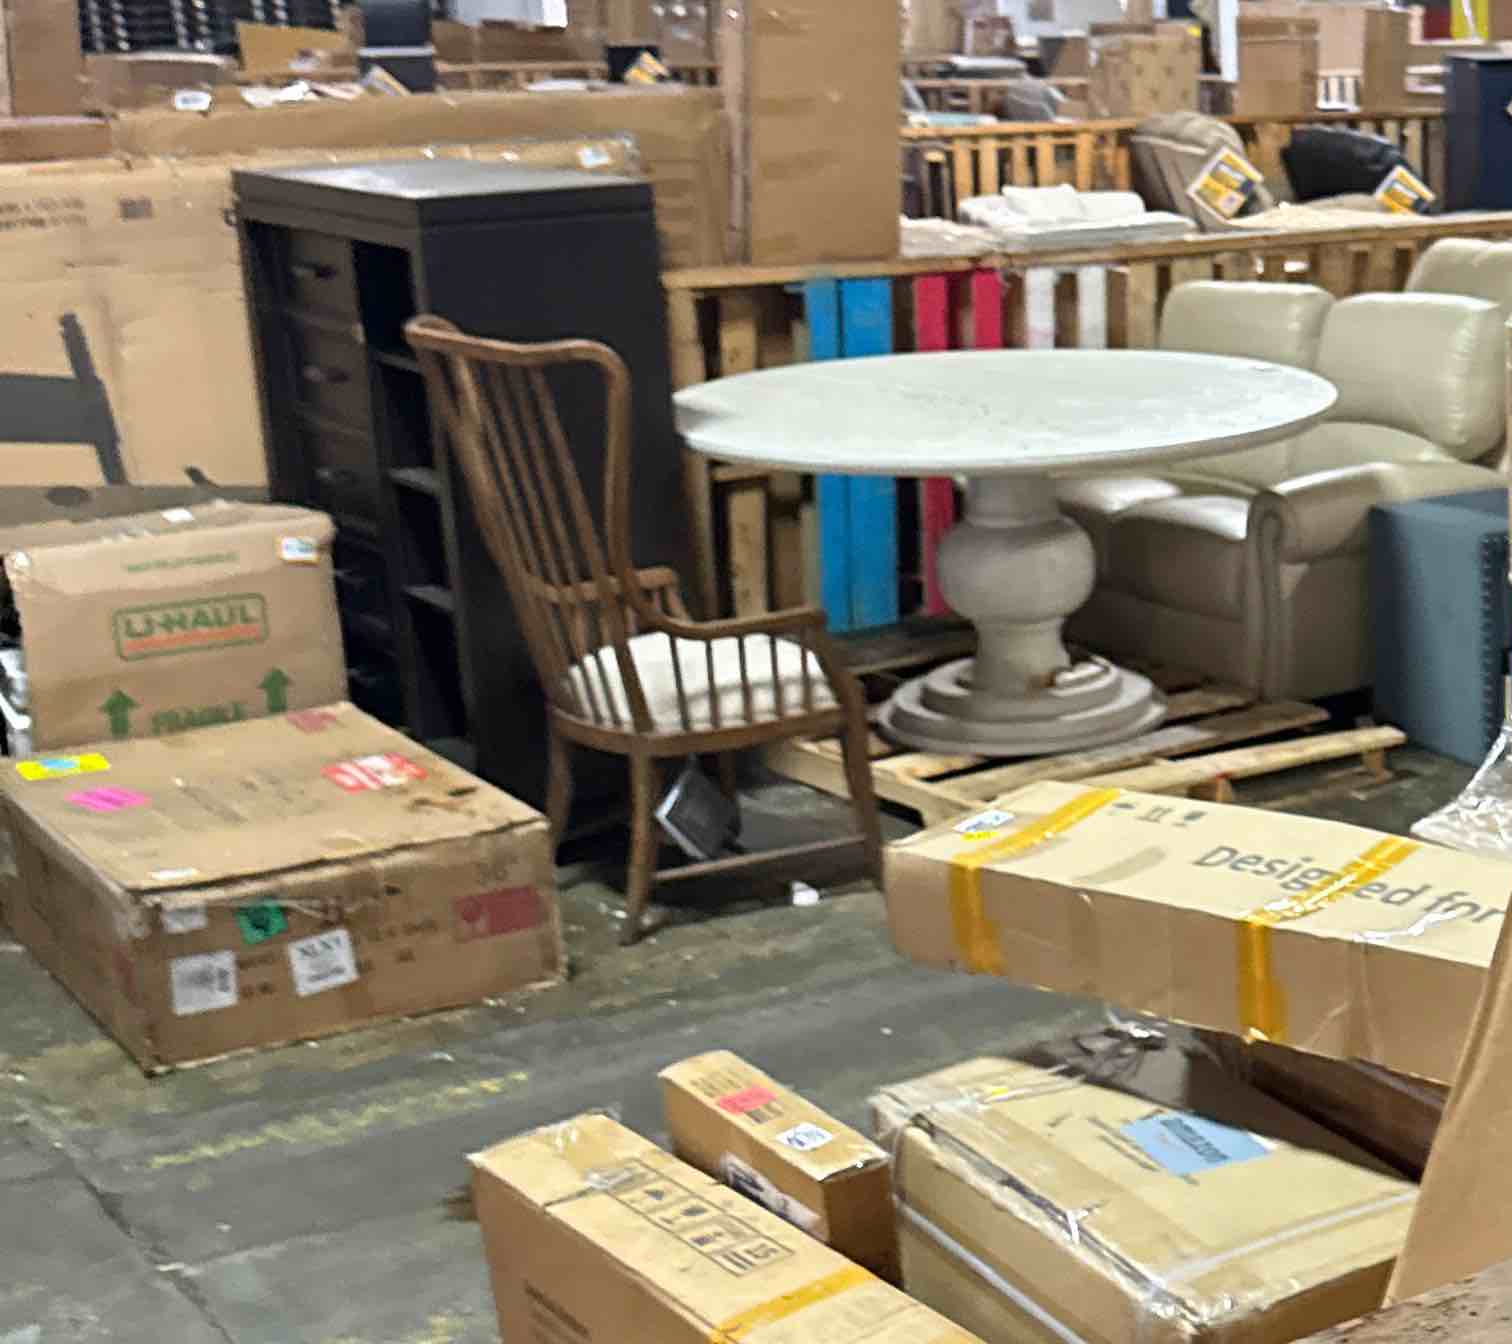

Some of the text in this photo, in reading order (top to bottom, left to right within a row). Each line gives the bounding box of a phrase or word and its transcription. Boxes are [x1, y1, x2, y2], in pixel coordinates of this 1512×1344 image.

[125, 606, 258, 637] U-HAUL
[1192, 845, 1505, 923] Desiged for
